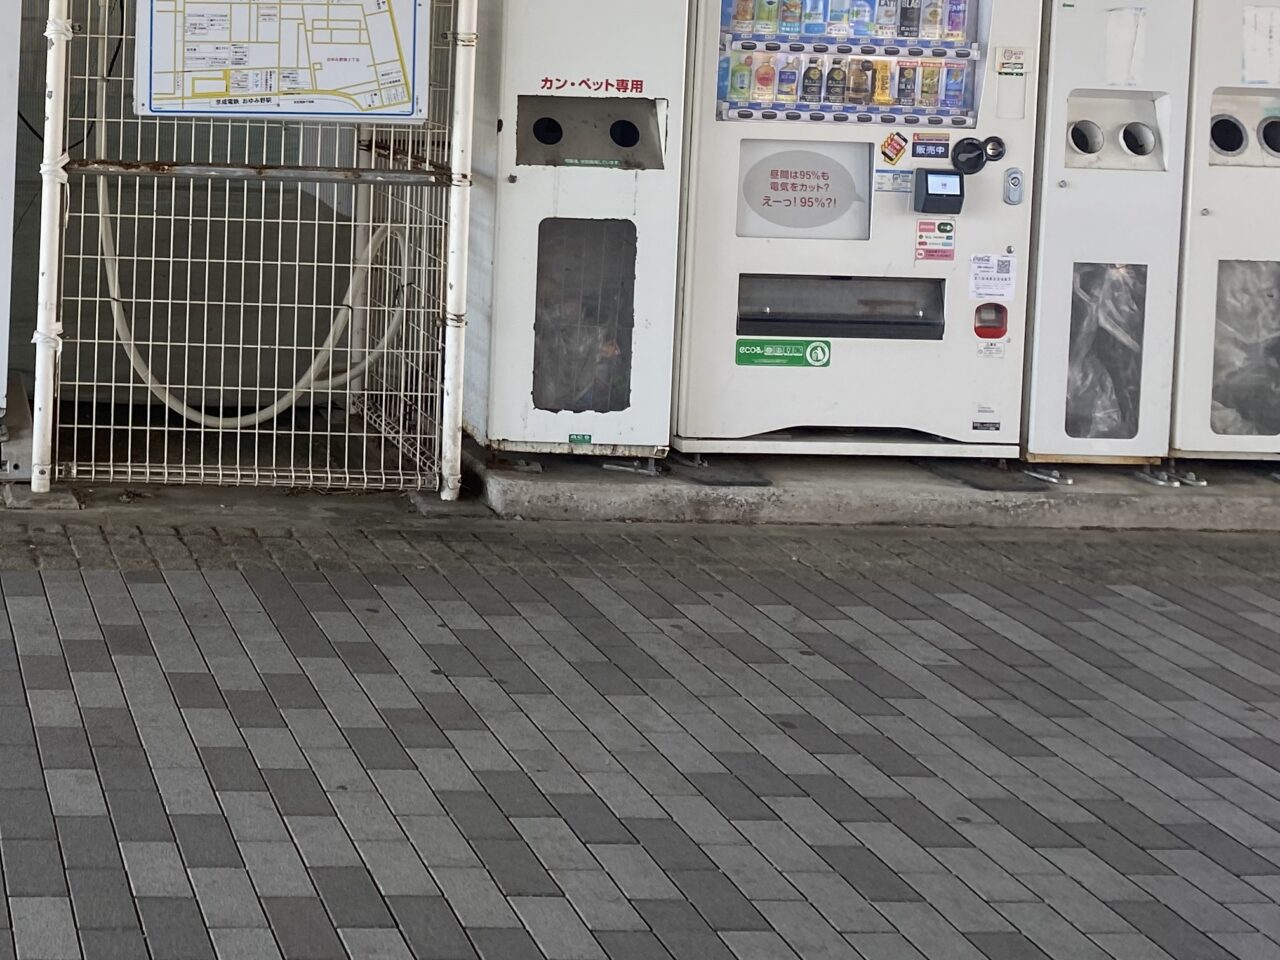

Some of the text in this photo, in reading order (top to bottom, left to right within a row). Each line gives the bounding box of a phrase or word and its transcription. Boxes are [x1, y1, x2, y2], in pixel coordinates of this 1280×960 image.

[540, 77, 644, 93] カン・ペット専用
[915, 145, 946, 155] 販売中
